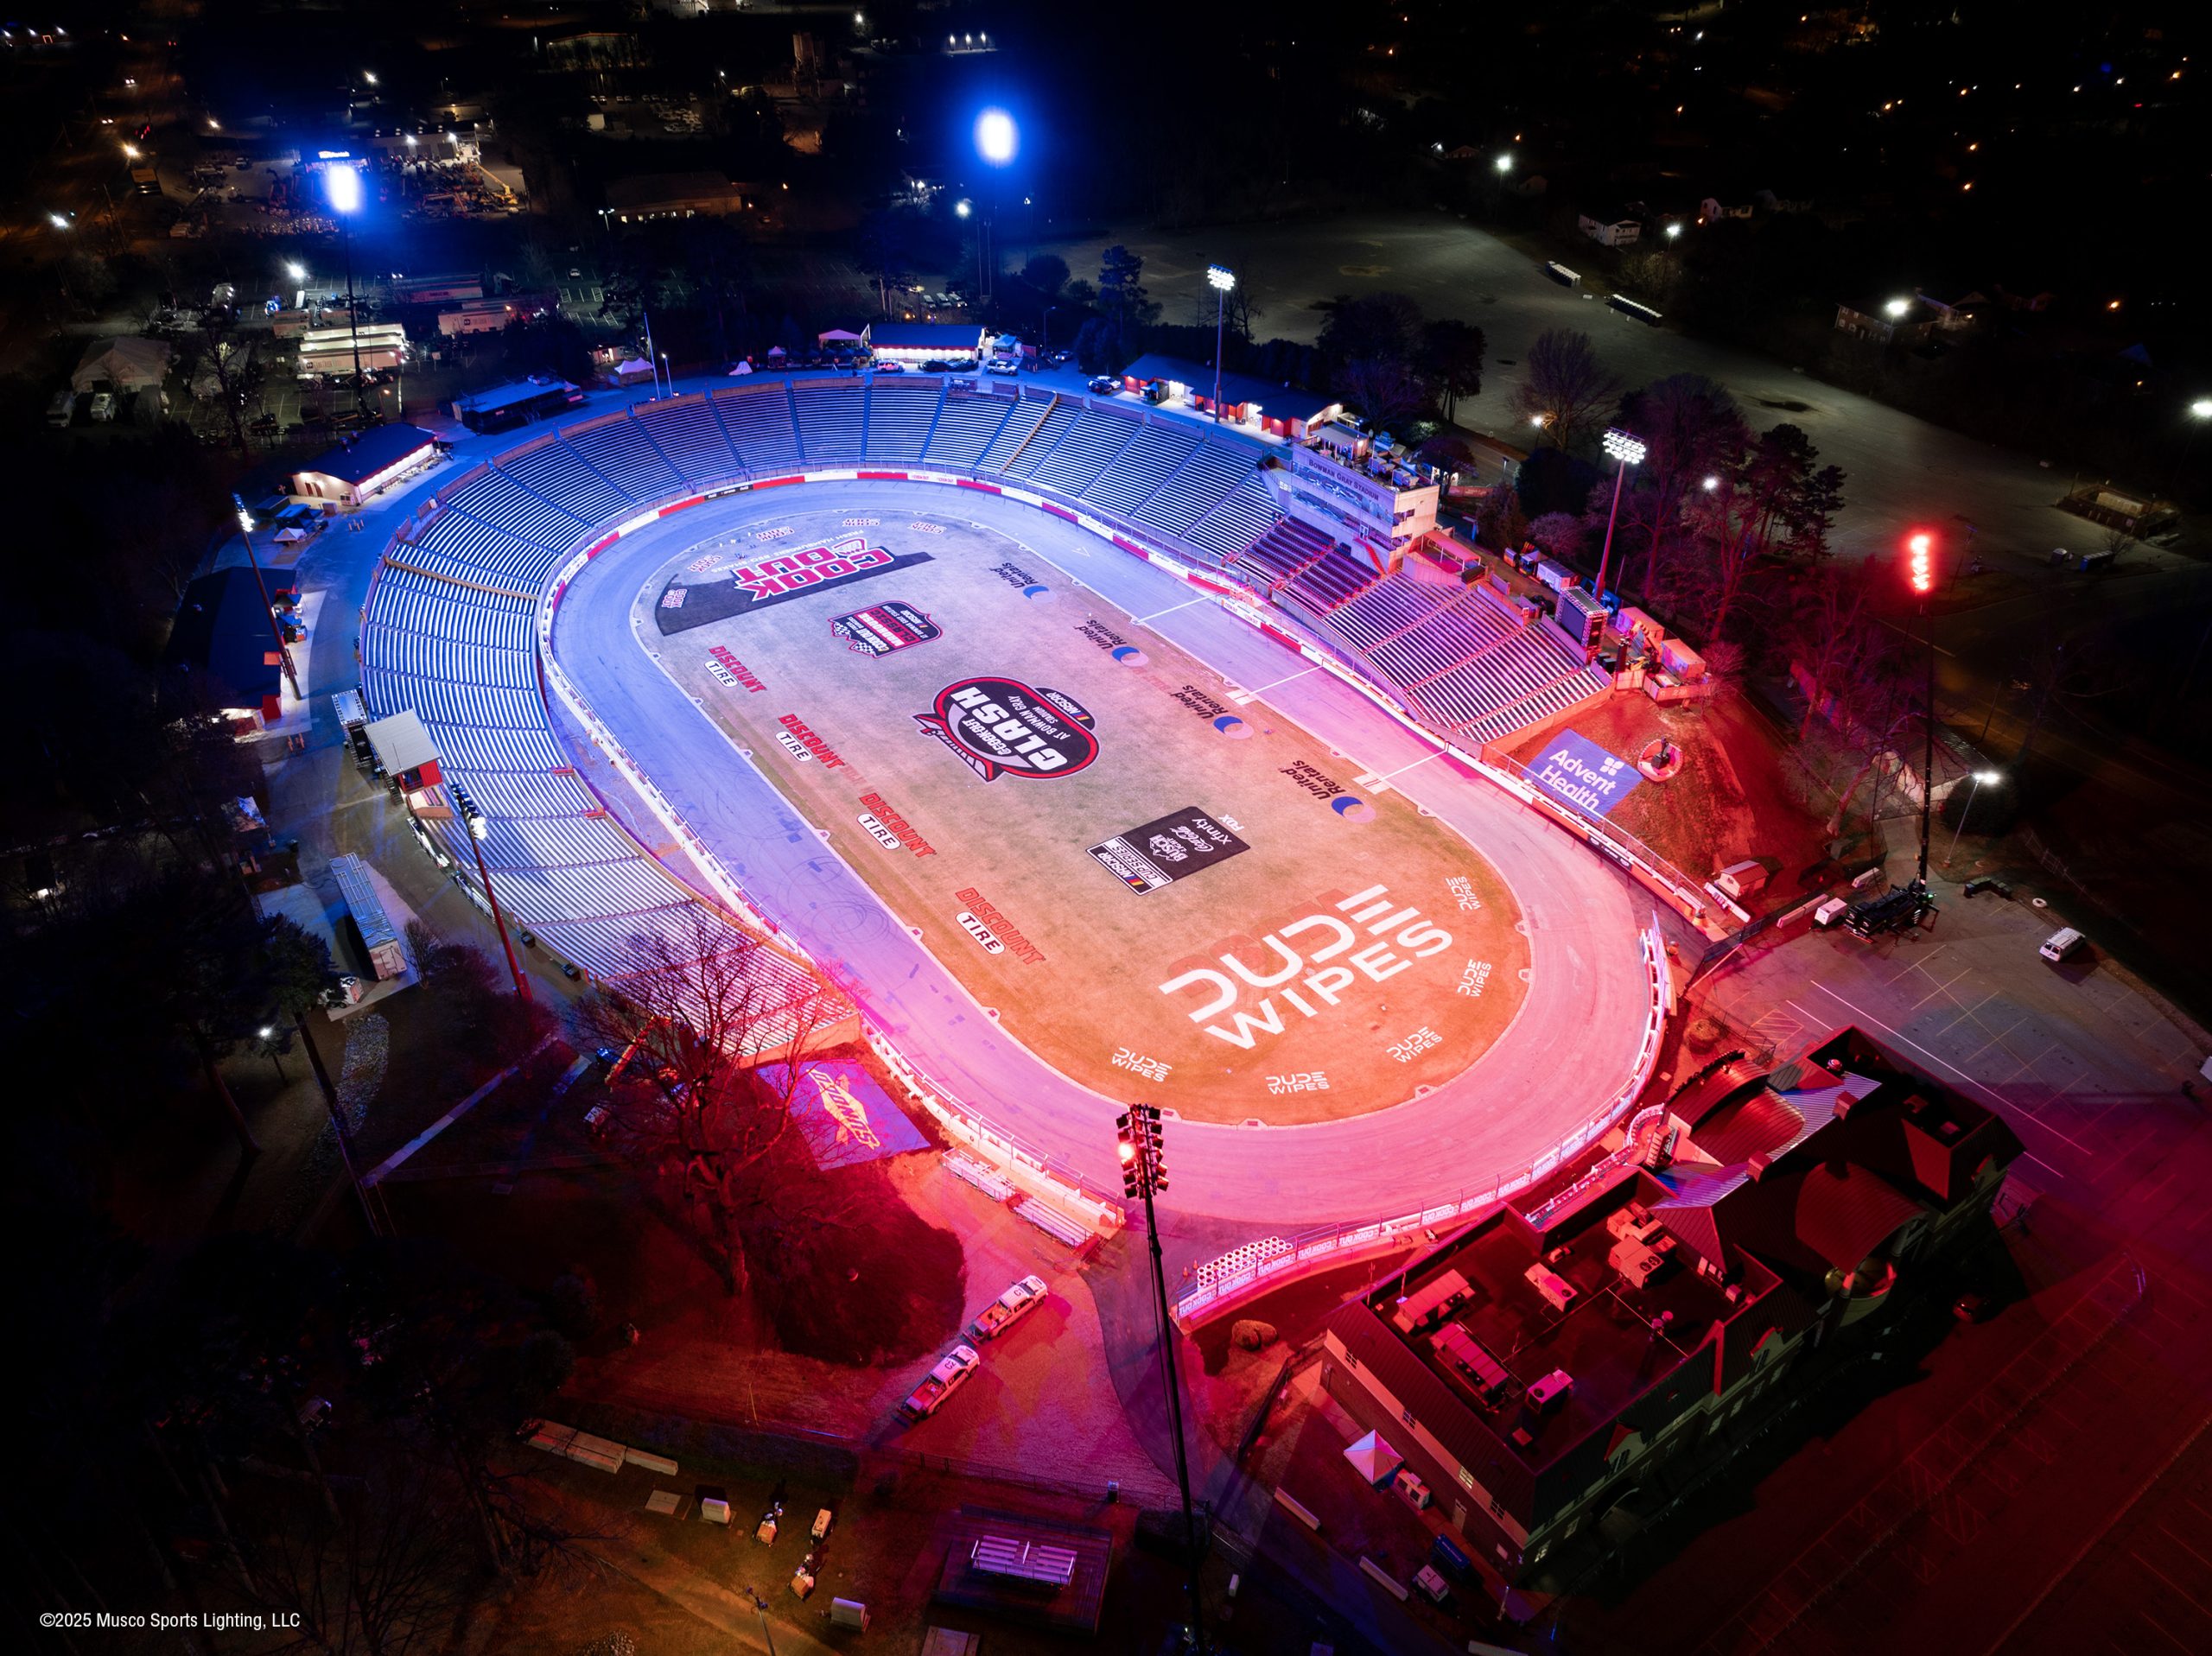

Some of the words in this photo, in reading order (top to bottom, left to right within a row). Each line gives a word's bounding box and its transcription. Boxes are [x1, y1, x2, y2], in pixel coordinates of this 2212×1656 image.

[1308, 459, 1336, 477] BOWMAN
[1336, 473, 1353, 486] GRAY
[1353, 481, 1379, 501] STADIUM
[835, 530, 864, 540] FRESH
[734, 547, 836, 584] OUT
[734, 546, 896, 602] COOK
[988, 567, 1026, 588] United
[1002, 562, 1039, 585] Rentals
[857, 612, 905, 646] MADHOUSE
[869, 610, 915, 642] CLASSIC
[1073, 625, 1114, 650] United
[1086, 619, 1128, 645] Rentals
[709, 645, 767, 693] DISCOUNT
[709, 663, 734, 685] TIRE
[1007, 695, 1026, 711] GRAY
[1032, 706, 1058, 724] STADIUM
[1046, 692, 1081, 714] NASCAR
[1170, 691, 1215, 720] United
[1182, 684, 1229, 715] Rentals
[950, 686, 1067, 770] CLASH
[1020, 710, 1053, 734] BOWMAN
[778, 714, 846, 769] DISCOUNT
[780, 733, 809, 762] TIRE
[1279, 767, 1332, 801] United
[1292, 759, 1346, 794] Rentals
[1540, 765, 1600, 810] Health
[1548, 749, 1616, 796] Advent
[859, 792, 938, 858] DISCOUNT
[862, 815, 896, 847] TIRE
[1192, 818, 1232, 846] xfinity
[1218, 814, 1245, 832] FOX
[1112, 846, 1145, 868] SERIES
[1149, 834, 1188, 862] BUSCH
[1097, 852, 1135, 878] NASCAR
[1138, 860, 1158, 879] CUP
[1446, 877, 1472, 911] DUDE
[1459, 875, 1481, 910] WIPES
[955, 886, 1046, 965] DISCOUNT
[962, 915, 1001, 951] TIRE
[1158, 884, 1421, 1024] DUDE
[1204, 919, 1452, 1050] WIPES
[1457, 958, 1483, 996] DUDE
[1470, 961, 1492, 998] WIPES
[1386, 1025, 1435, 1059] DUDE
[1396, 1034, 1443, 1064] WIPES
[1111, 1056, 1166, 1083] WIPES
[1118, 1046, 1173, 1072] DUDE
[1265, 1070, 1328, 1087] DUDE
[1269, 1080, 1331, 1095] WIPES
